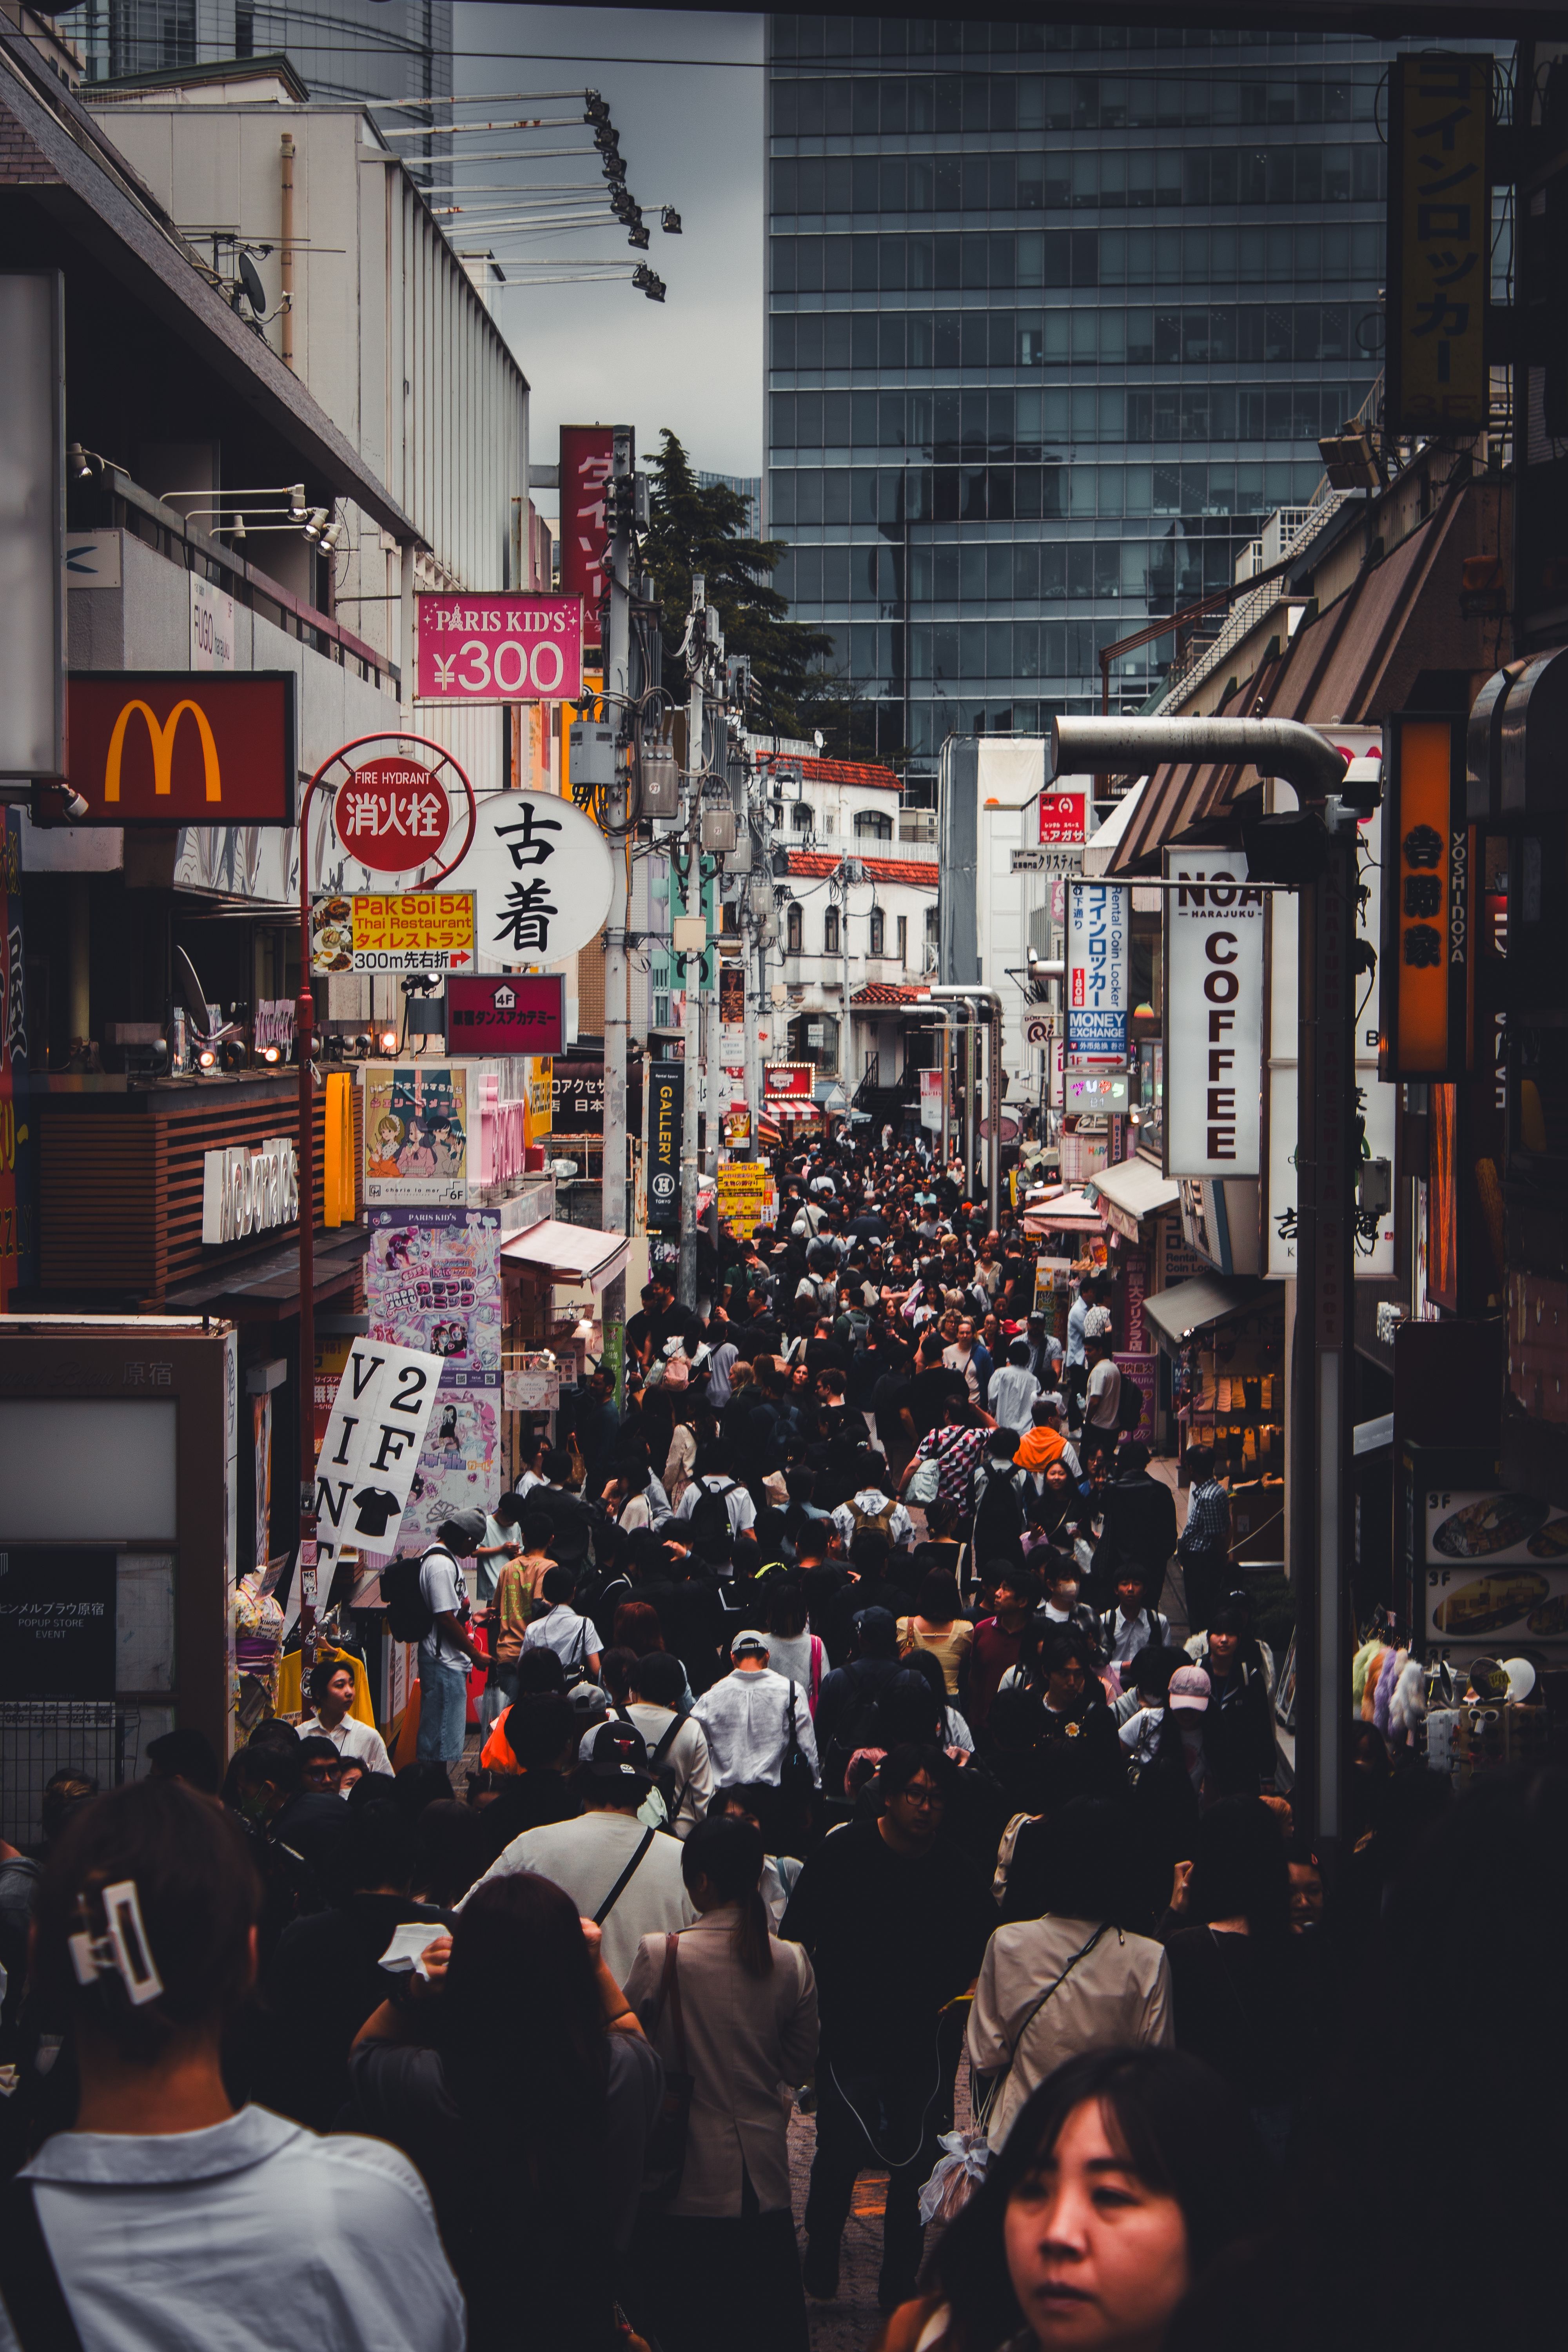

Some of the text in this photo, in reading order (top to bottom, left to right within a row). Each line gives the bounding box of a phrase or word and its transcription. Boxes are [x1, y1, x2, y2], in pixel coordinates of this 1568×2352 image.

[1410, 64, 1479, 383] コインロッカー
[1407, 395, 1478, 421] 3F
[436, 603, 502, 632] PARIS
[506, 610, 566, 632] KID'S
[194, 604, 213, 655] FUGO
[214, 631, 230, 663] harajuku
[433, 641, 564, 691] ¥300
[355, 772, 431, 784] FIRE HYDRANT
[346, 792, 442, 837] 消火栓
[1050, 829, 1084, 842] アガサ
[1038, 854, 1081, 870] クリスティー
[492, 802, 563, 953] 古着
[354, 897, 471, 915] Pak Soi 54
[1450, 832, 1466, 963] YOSHINOYA
[355, 917, 472, 929] Thai Restaurant
[1191, 910, 1255, 918] HARAJUKU
[356, 931, 472, 948] タイレストラン
[1089, 886, 1107, 1007] コインロッカー
[1111, 887, 1122, 1007] Rental Coin Locker
[354, 951, 449, 969] 300m先右折
[1074, 969, 1083, 1005] 180個
[496, 992, 513, 1005] 4F
[1069, 1013, 1125, 1027] MONEY
[1069, 1027, 1125, 1038] EXCHANGE
[1203, 931, 1239, 1159] COFFEE
[1069, 1054, 1083, 1065] 1F
[1323, 1031, 1340, 1200] TAKESHITA
[659, 1085, 673, 1165] GALLERY
[450, 1190, 463, 1200] 6F
[436, 1213, 457, 1221] KID'S
[1165, 1254, 1198, 1262] Rental
[1165, 1263, 1189, 1272] Coin
[122, 1361, 173, 1387] 原宿
[370, 1366, 427, 1472] 2F
[1428, 1494, 1451, 1510] 3F
[1428, 1571, 1451, 1586] 3F
[18, 1619, 84, 1628] POPUP STORE
[36, 1630, 66, 1639] EVENT
